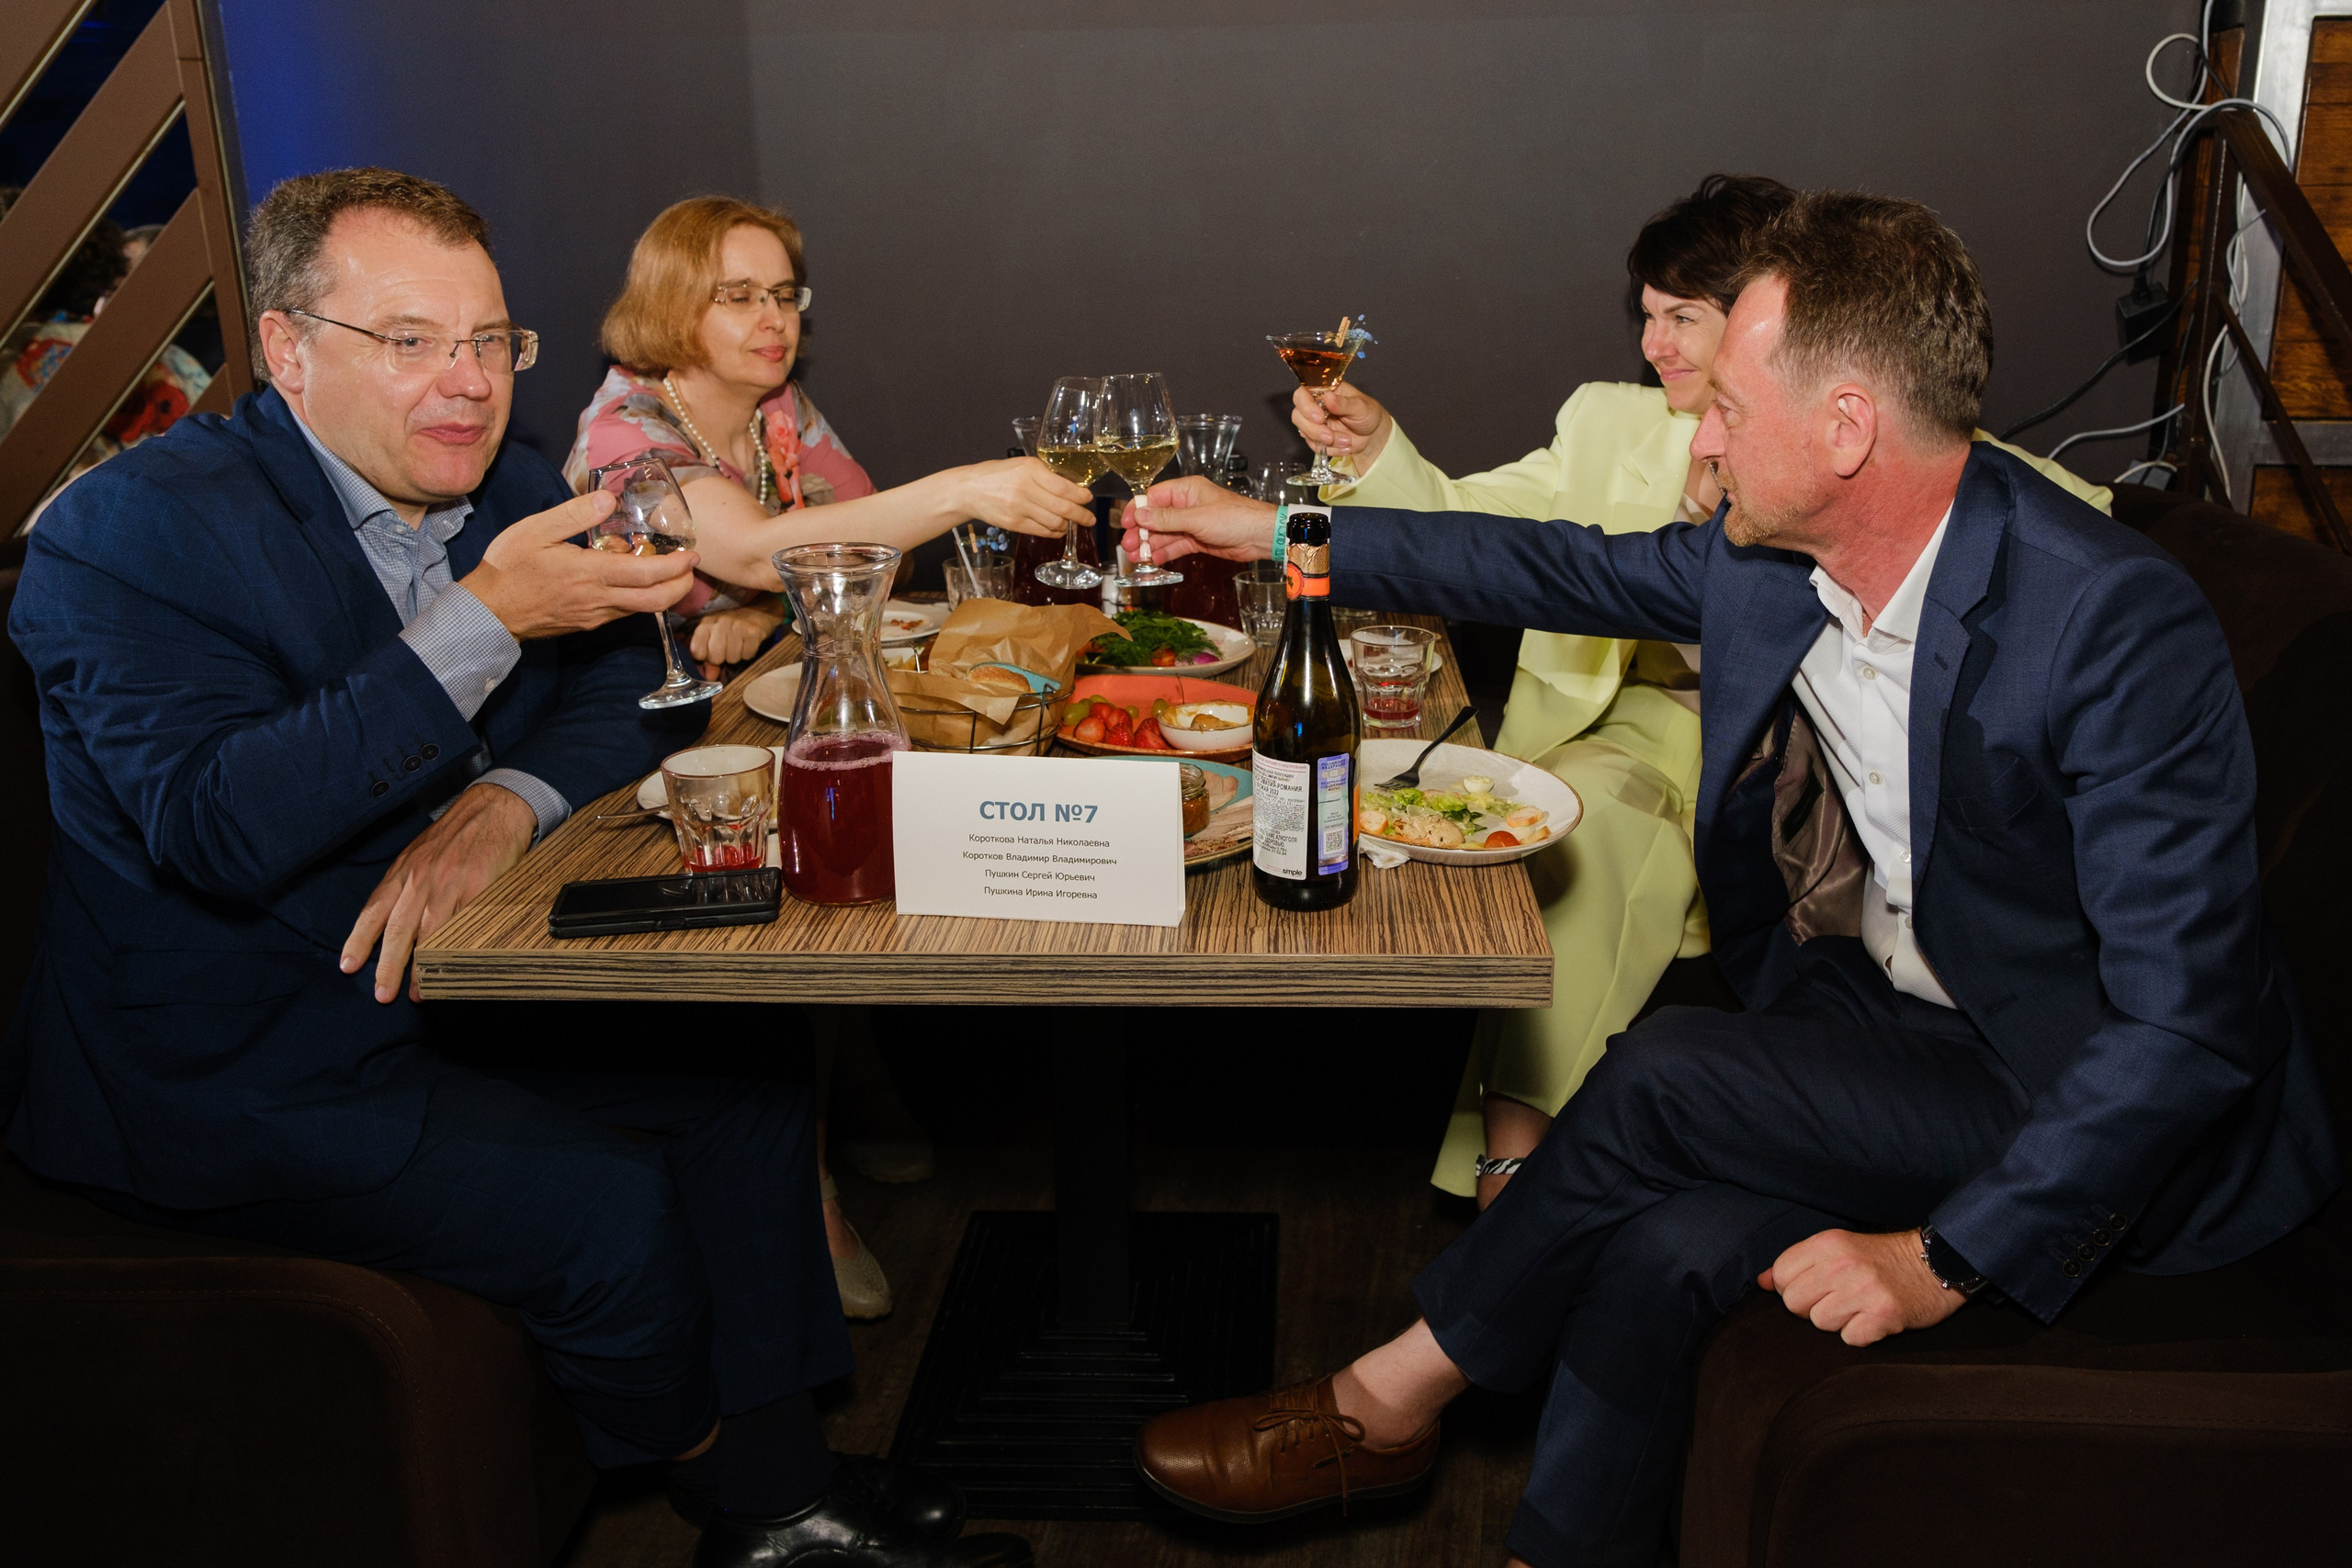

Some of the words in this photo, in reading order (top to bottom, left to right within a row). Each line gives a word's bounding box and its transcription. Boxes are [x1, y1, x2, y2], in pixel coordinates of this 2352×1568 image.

[979, 801, 1045, 821] СТОЛ
[1056, 804, 1098, 823] №7
[968, 834, 1015, 844] Короткова
[1017, 836, 1054, 845] Наталья
[1056, 838, 1110, 848] Николаевна
[962, 851, 1004, 862] Коротков
[1006, 853, 1050, 864] Владимир
[1052, 854, 1117, 866] Владимирович
[985, 869, 1020, 879] Пушкин
[1022, 870, 1053, 881] Сергей
[1055, 872, 1096, 883] Юрьевич
[984, 886, 1023, 897] Пушкина
[1025, 888, 1054, 898] Ирина
[1056, 890, 1098, 900] Игоревна
